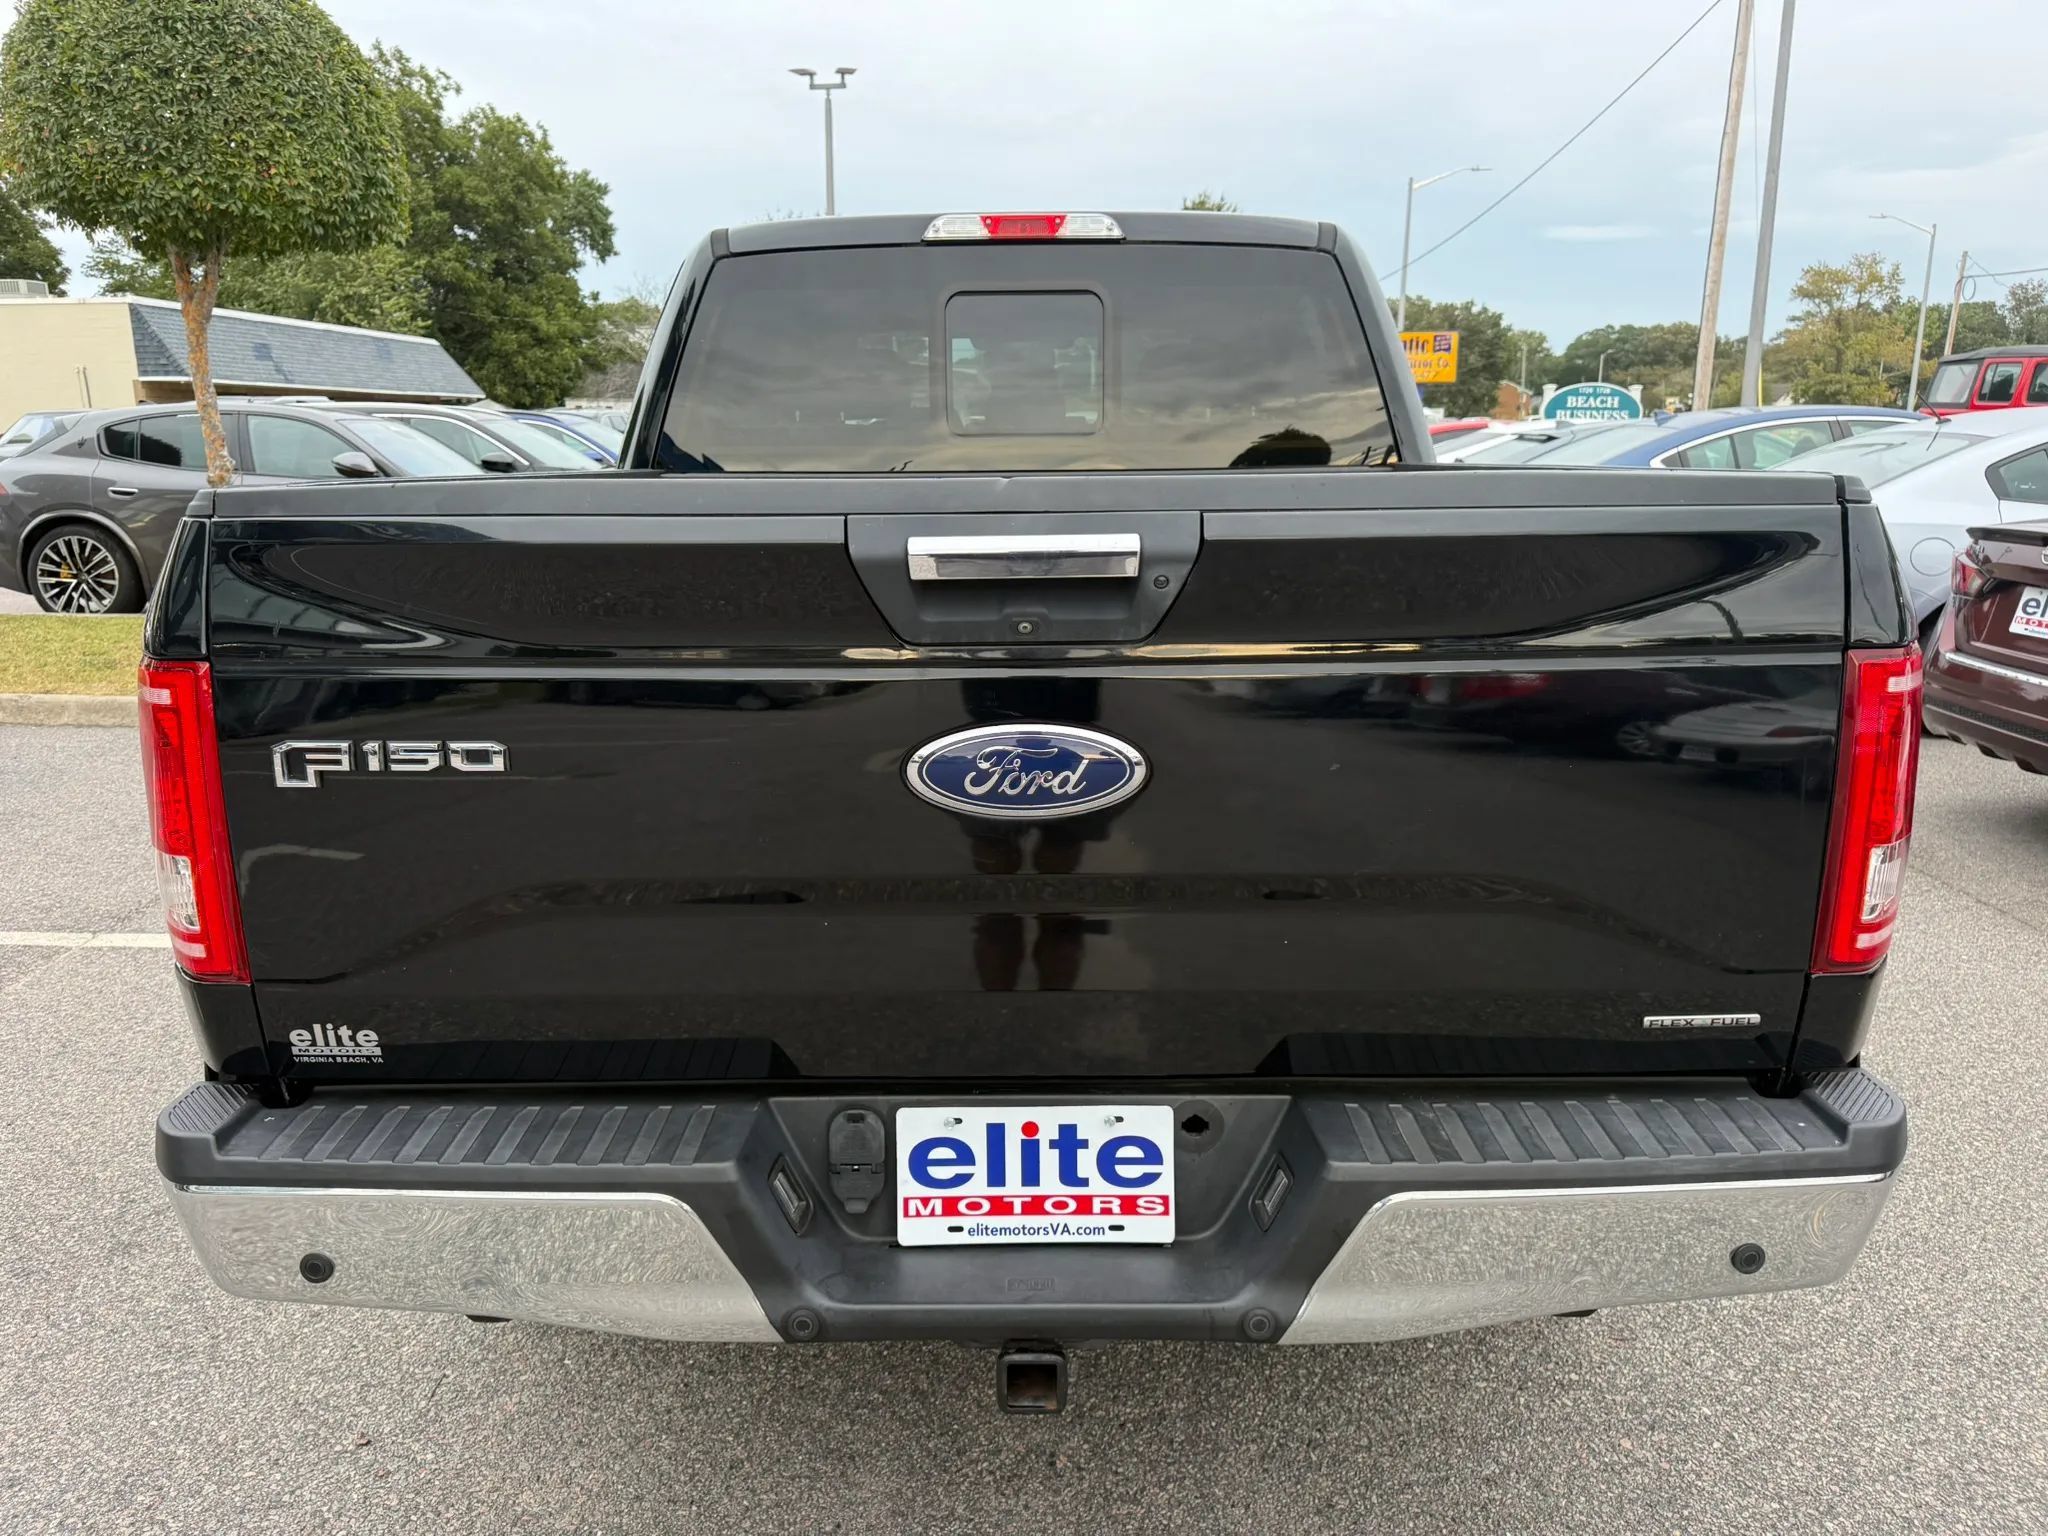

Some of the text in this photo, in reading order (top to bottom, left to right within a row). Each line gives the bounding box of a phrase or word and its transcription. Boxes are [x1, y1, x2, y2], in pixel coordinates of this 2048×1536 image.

[1566, 395, 1620, 408] BEACH
[1555, 409, 1630, 421] BUSINESS
[271, 740, 510, 788] F150
[963, 746, 1089, 796] Ford
[1648, 1017, 1757, 1028] FLEX FUEL
[288, 1022, 379, 1048] elite
[336, 1056, 370, 1064] BEACH,
[908, 1121, 1164, 1189] elite
[907, 1196, 1165, 1217] MOTORS
[967, 1222, 1106, 1238] elitemotorsVA.com
